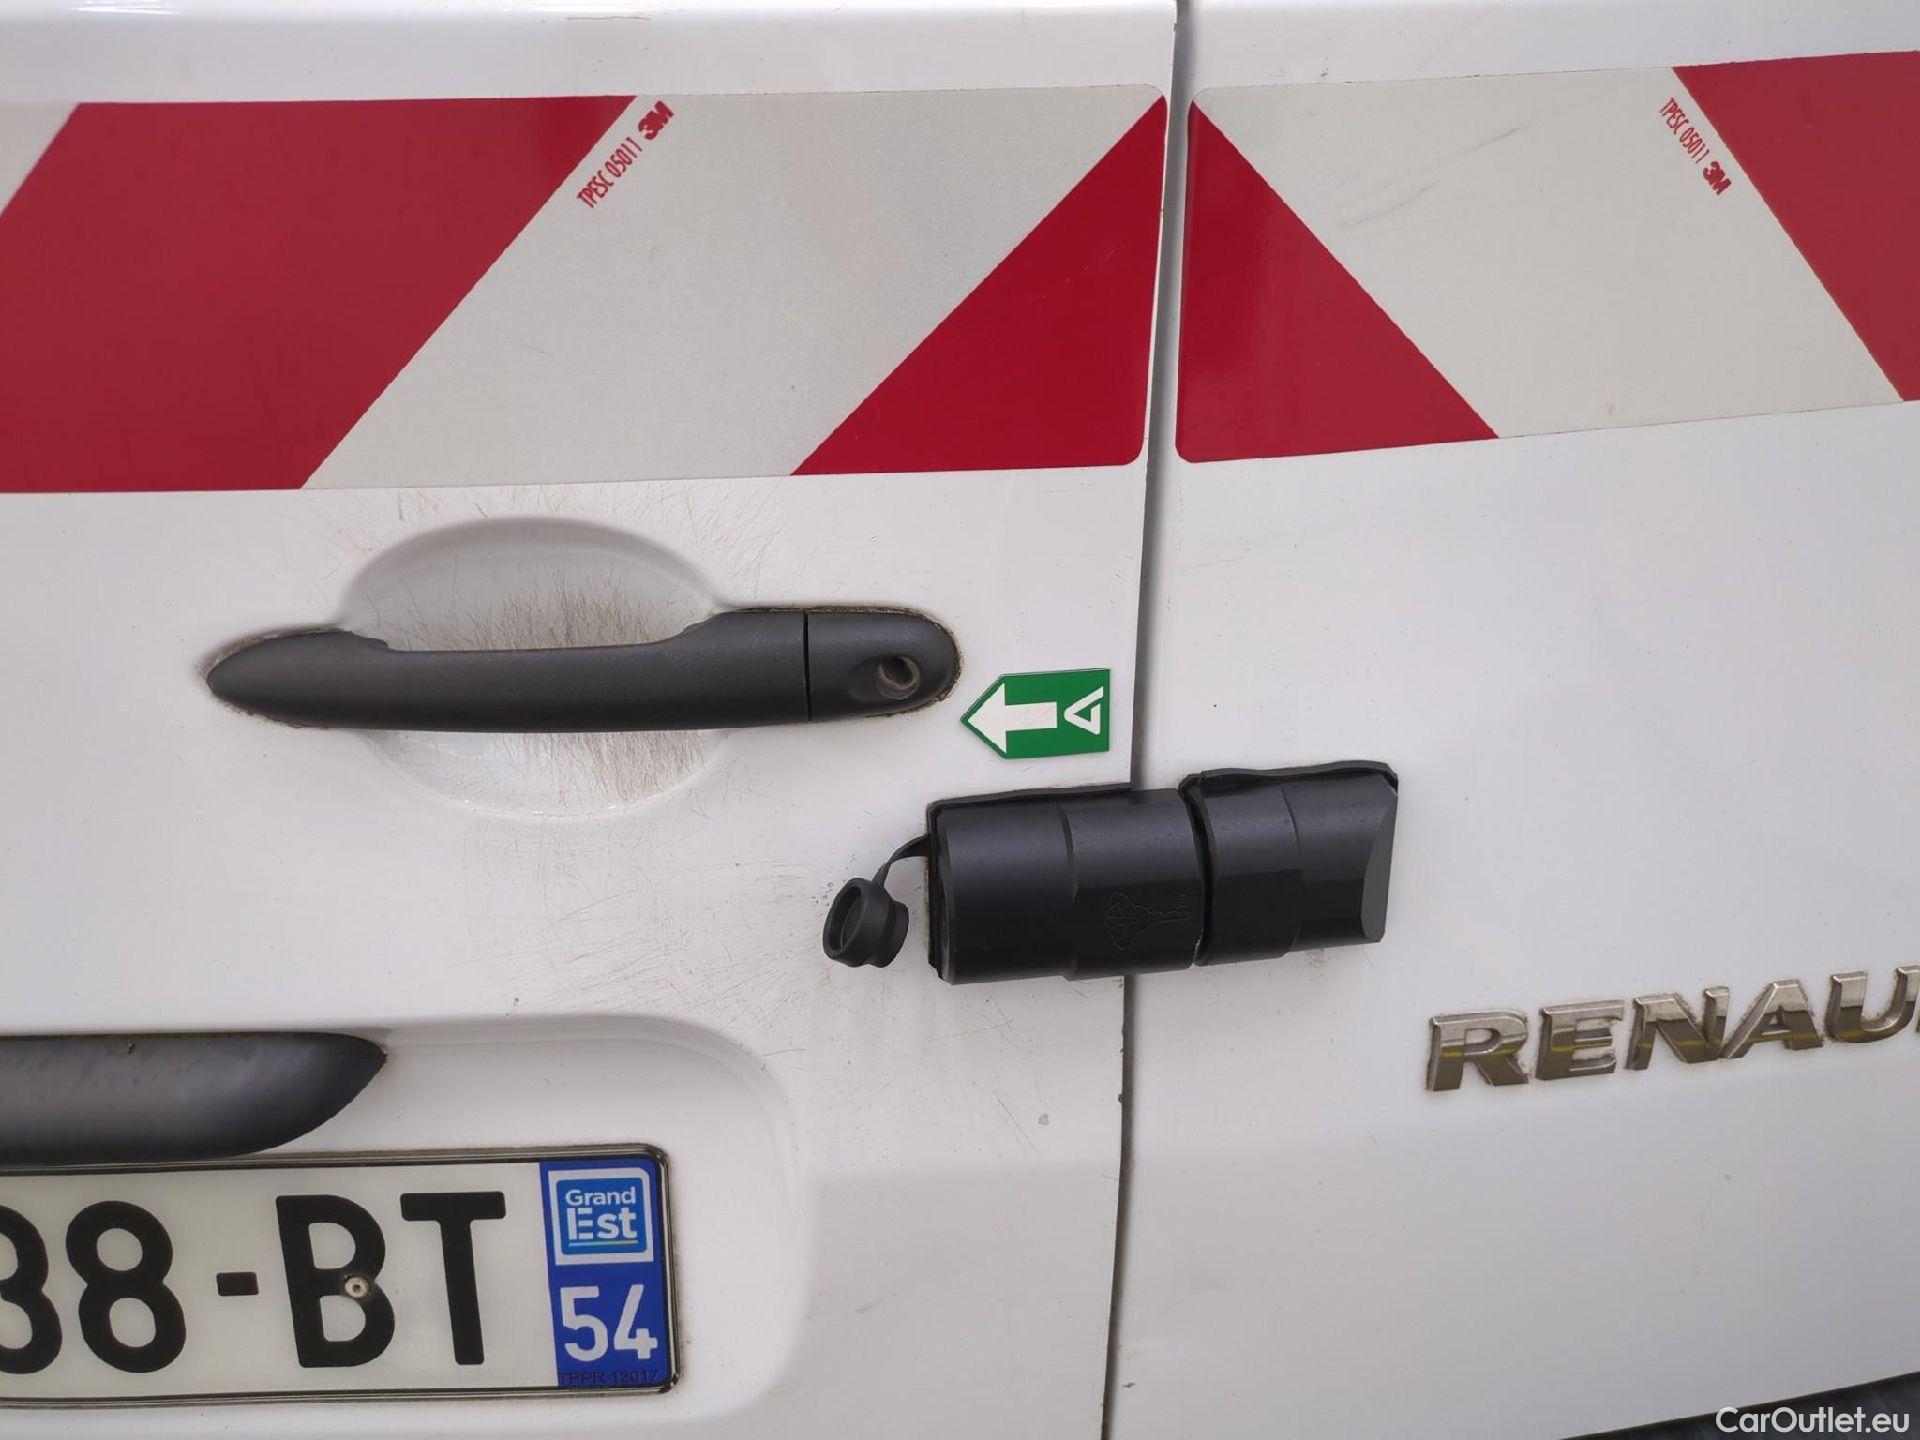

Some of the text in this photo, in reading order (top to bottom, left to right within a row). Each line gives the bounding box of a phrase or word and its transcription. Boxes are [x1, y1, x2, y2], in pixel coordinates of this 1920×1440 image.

[577, 99, 674, 208] TPESC 05011 3M
[1659, 97, 1732, 195] TPESC 05011 3M
[1425, 964, 1920, 1091] RENAU
[564, 1186, 637, 1205] Grand
[566, 1206, 638, 1240] Est
[560, 1283, 658, 1362] 54
